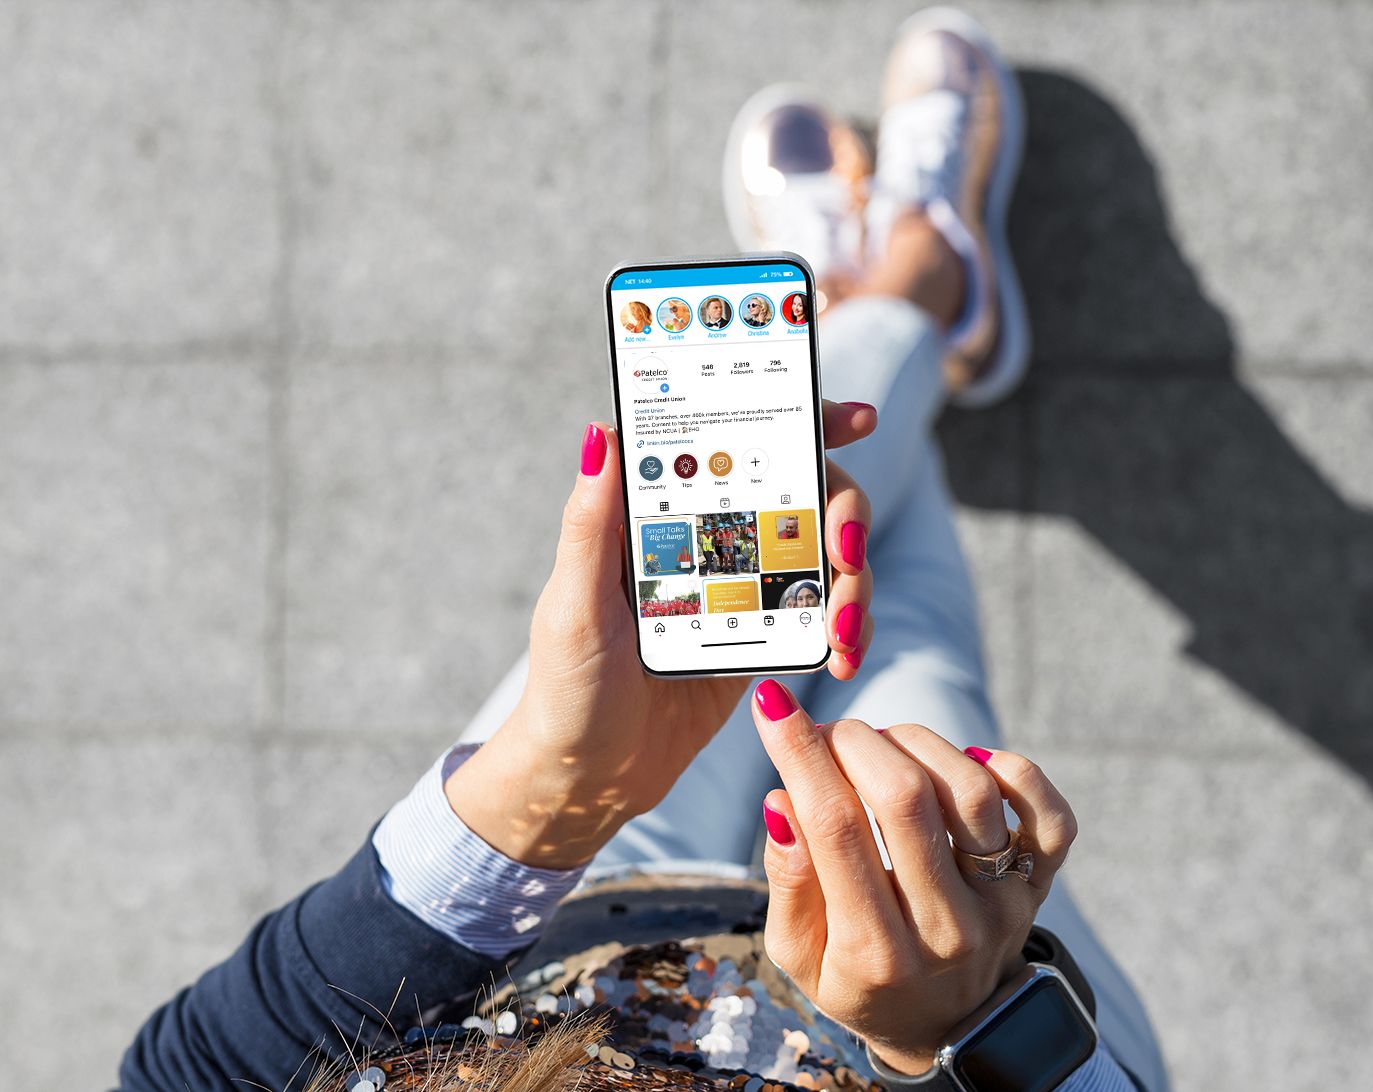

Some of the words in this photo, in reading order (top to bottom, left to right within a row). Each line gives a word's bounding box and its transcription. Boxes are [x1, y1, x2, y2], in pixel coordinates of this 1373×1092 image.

[733, 361, 750, 369] 2,819
[640, 368, 669, 377] Patelco
[645, 527, 666, 535] Small
[649, 534, 661, 542] Big
[661, 533, 686, 541] Change
